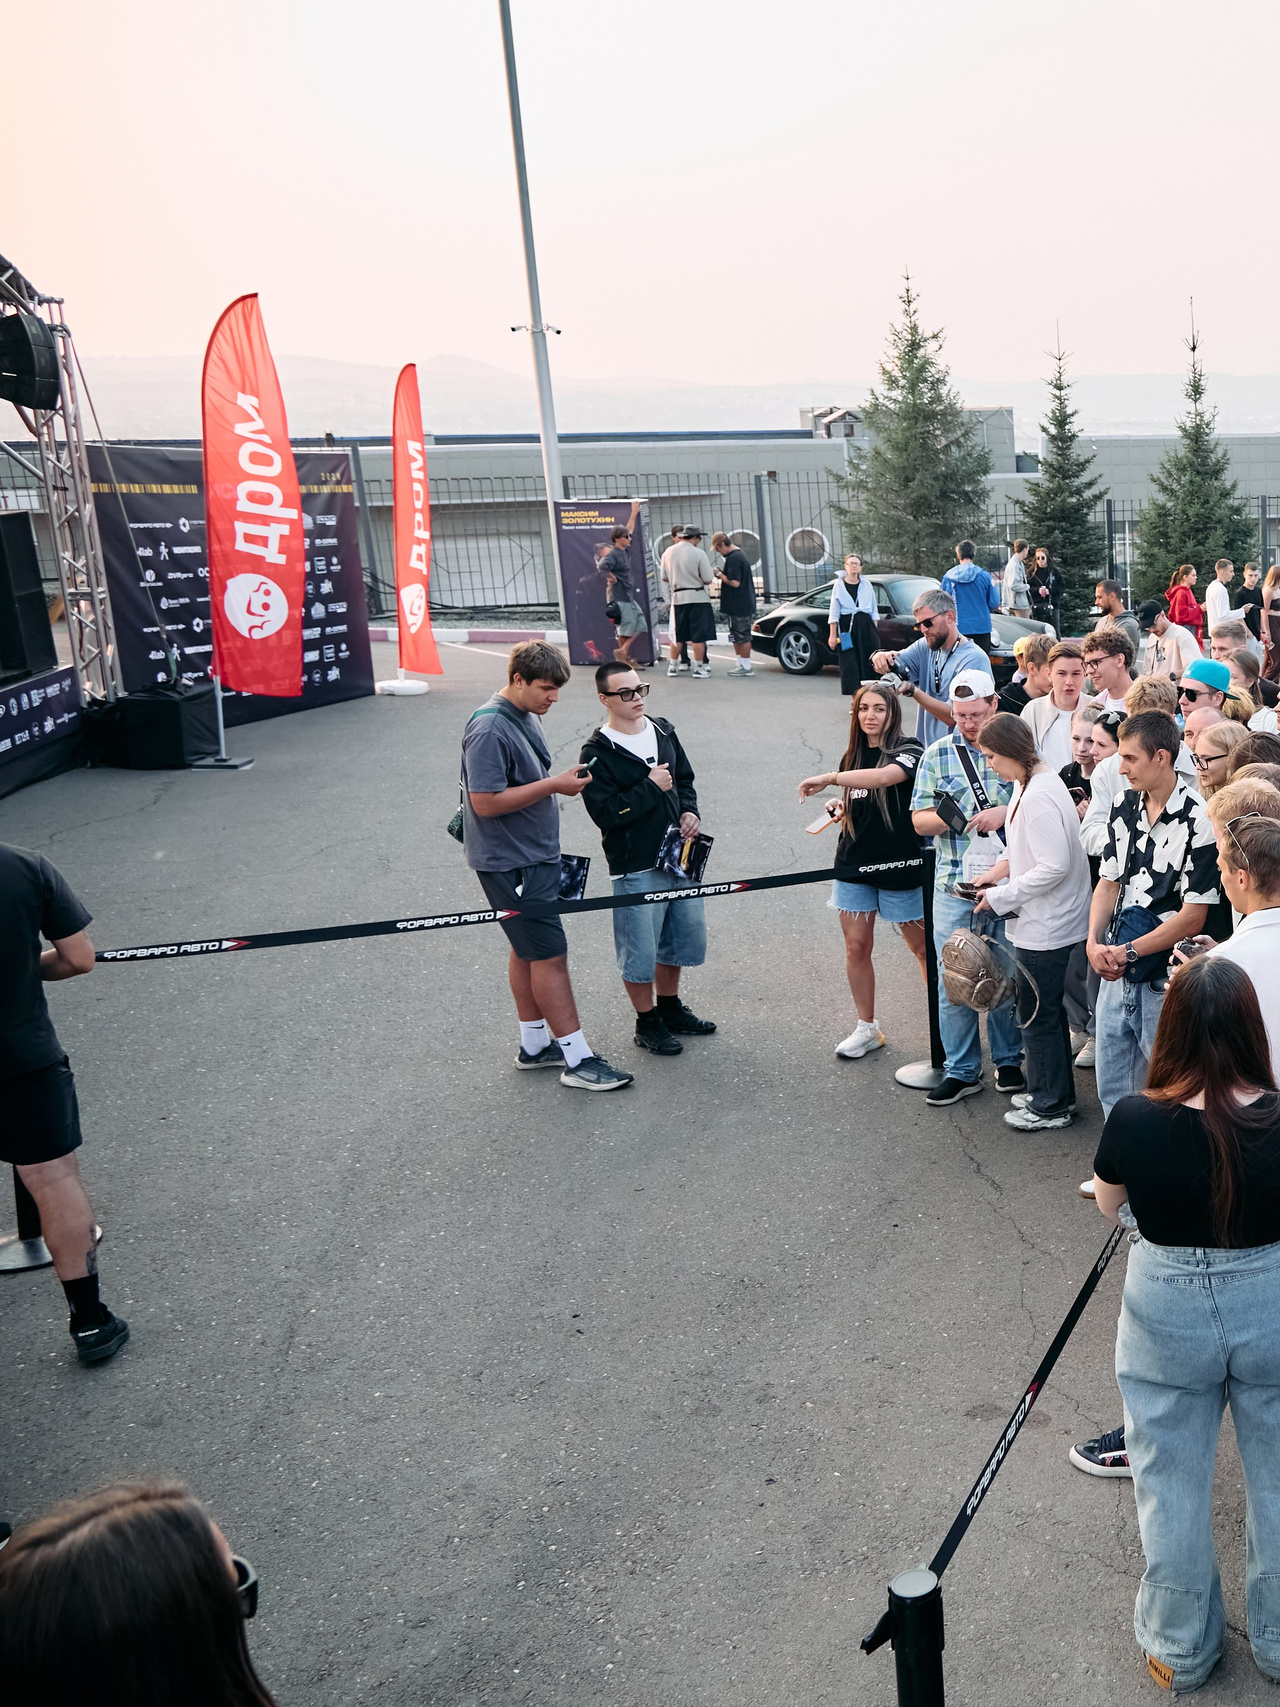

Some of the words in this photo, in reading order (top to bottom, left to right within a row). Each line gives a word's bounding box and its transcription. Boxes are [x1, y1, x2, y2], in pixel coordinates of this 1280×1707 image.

[560, 510, 599, 518] МАКСИМ
[561, 516, 615, 524] ЗОЛОТУХИН
[906, 858, 923, 867] АВТ
[644, 888, 699, 902] ФОРВАРД
[699, 884, 729, 895] АВТО
[396, 915, 460, 930] ФОРВАРД
[460, 911, 495, 923] АВТО
[103, 945, 179, 960] ФОРВАРД
[180, 941, 220, 954] АВТО
[966, 1438, 1006, 1517] ФОРВАРД
[1005, 1402, 1026, 1449] АВТО
